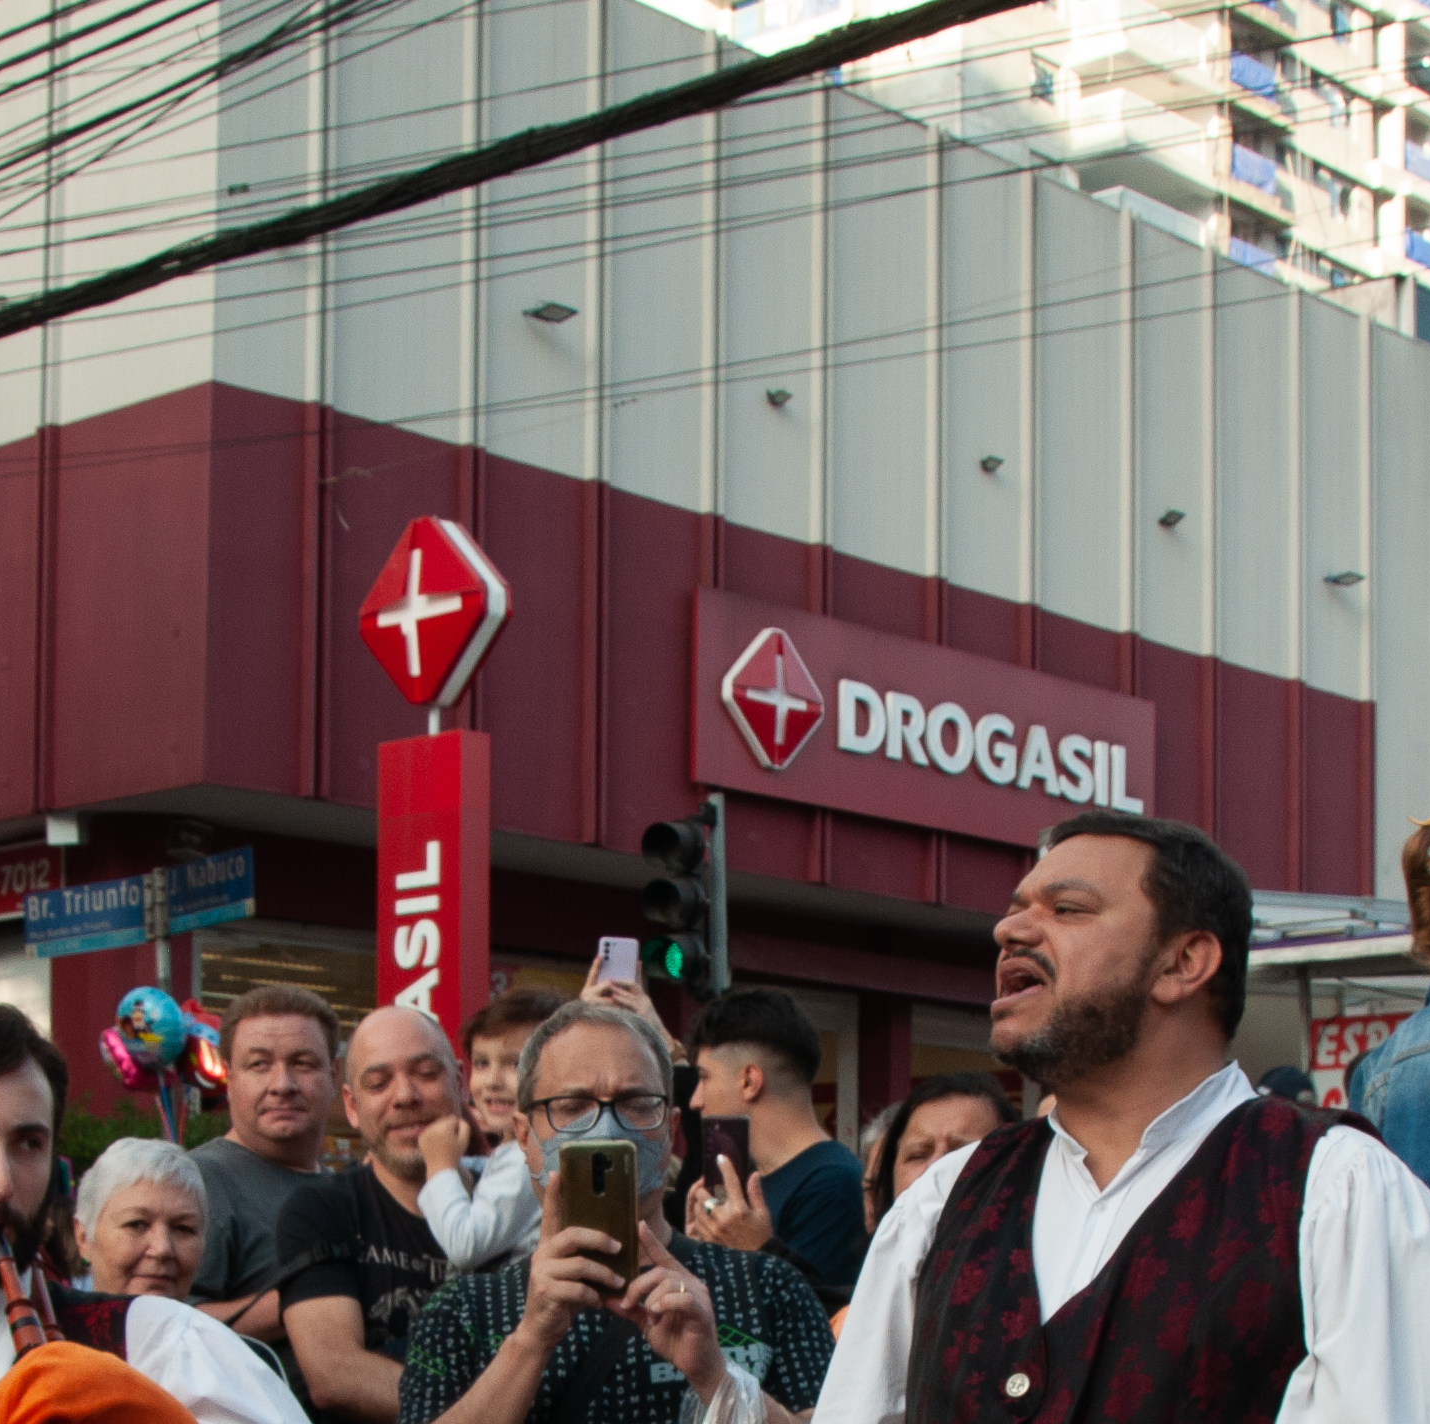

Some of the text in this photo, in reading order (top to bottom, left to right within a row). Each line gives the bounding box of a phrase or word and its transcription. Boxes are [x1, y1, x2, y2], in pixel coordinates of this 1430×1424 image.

[837, 678, 1144, 815] DROGASIL
[186, 854, 246, 889] Nabuco
[27, 893, 56, 922] Br.
[62, 879, 141, 916] Triunfo
